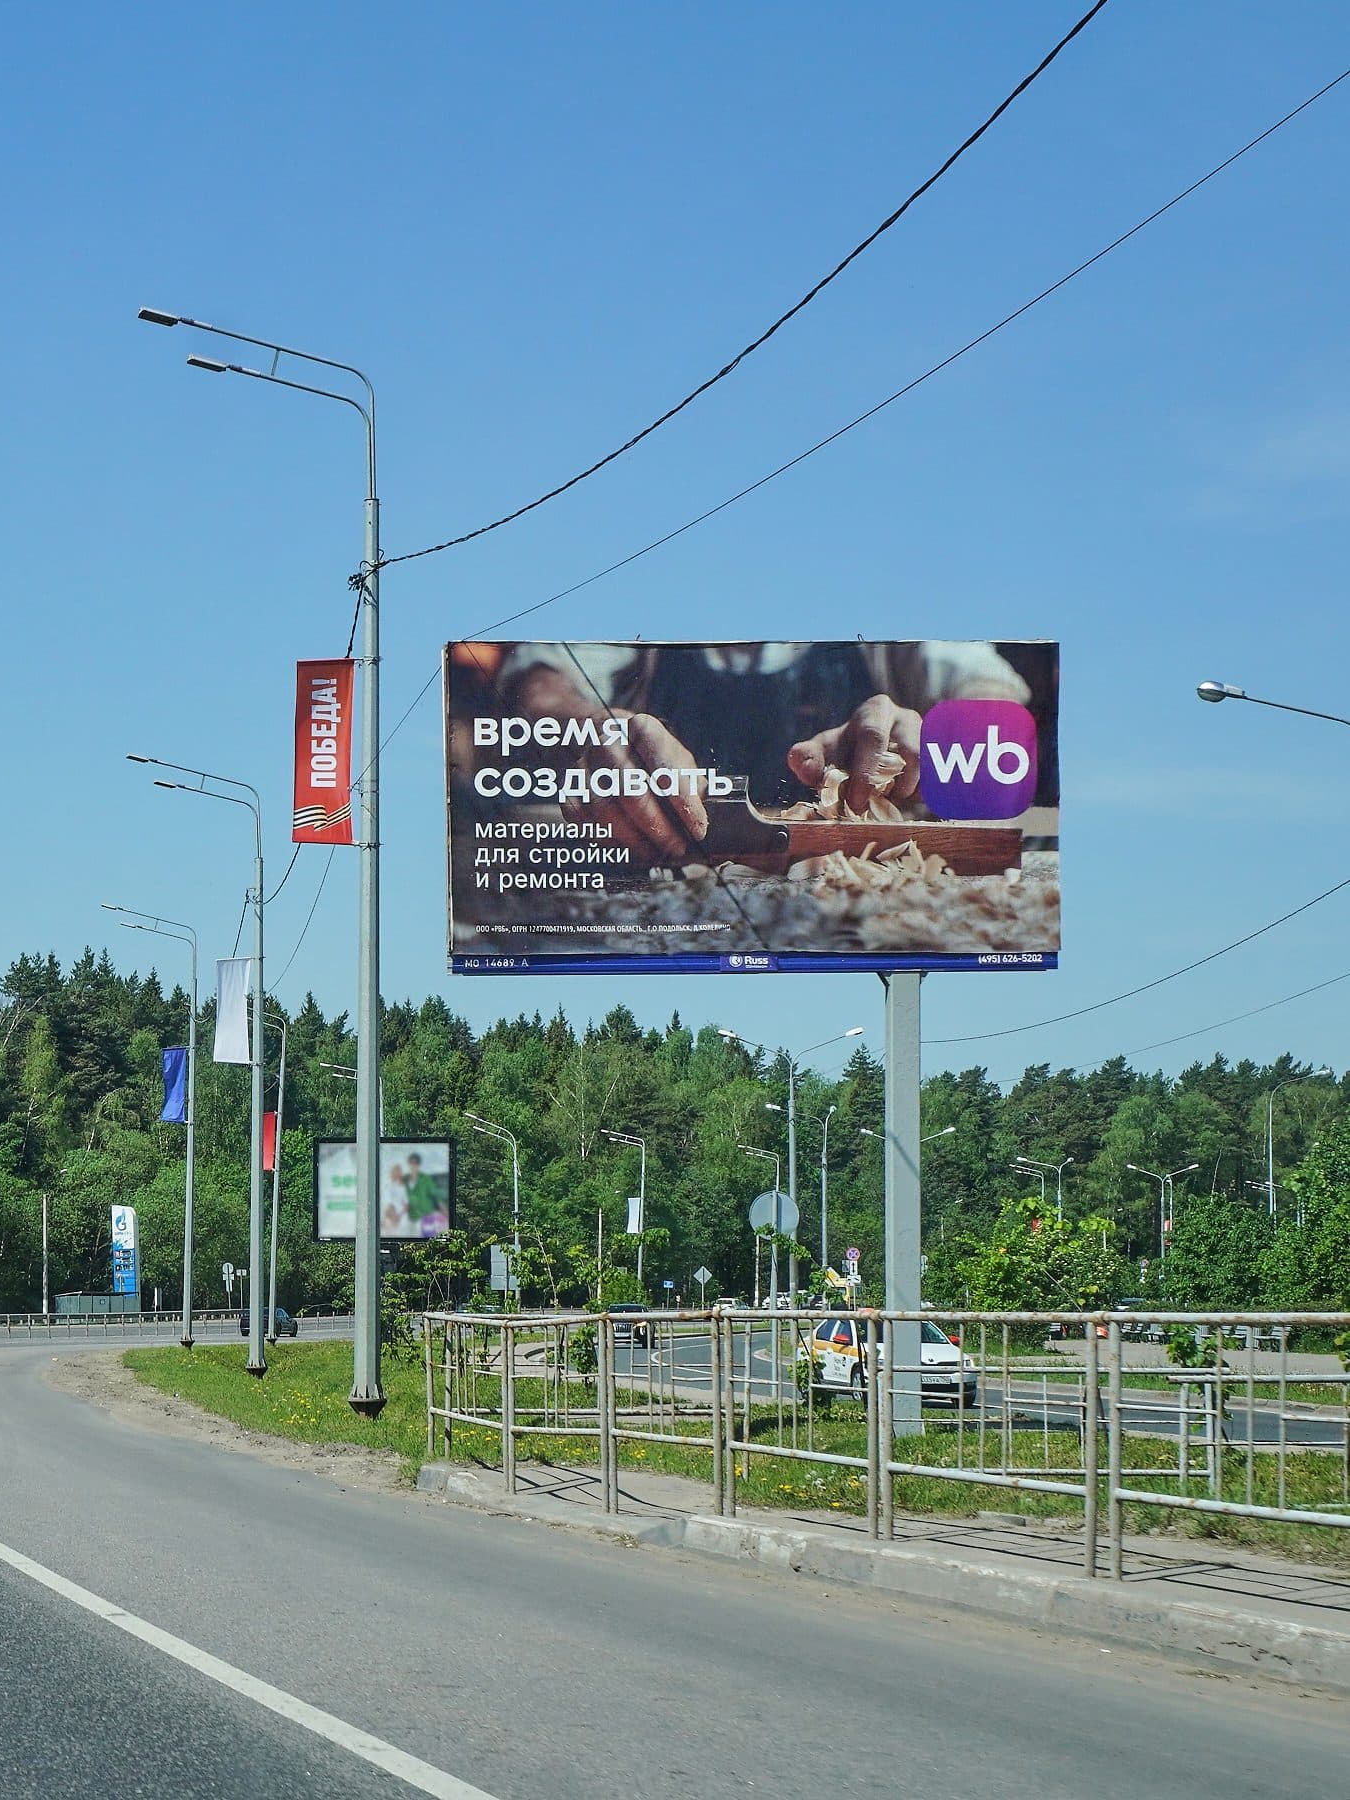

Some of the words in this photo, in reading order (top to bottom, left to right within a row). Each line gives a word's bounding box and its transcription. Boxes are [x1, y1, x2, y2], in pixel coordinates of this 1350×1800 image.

[310, 678, 341, 788] ПОБЕДА!
[473, 717, 629, 757] время
[926, 725, 1029, 784] wb
[474, 768, 734, 803] создавать
[475, 822, 612, 843] материалы
[474, 847, 519, 867] для
[529, 843, 629, 868] стройки
[475, 872, 489, 888] и
[499, 872, 604, 893] ремонта
[475, 925, 490, 933] ООО
[485, 958, 515, 967] 14689
[744, 955, 769, 965] Russ
[978, 954, 1000, 964] (495)
[1002, 953, 1043, 963] 626-5202
